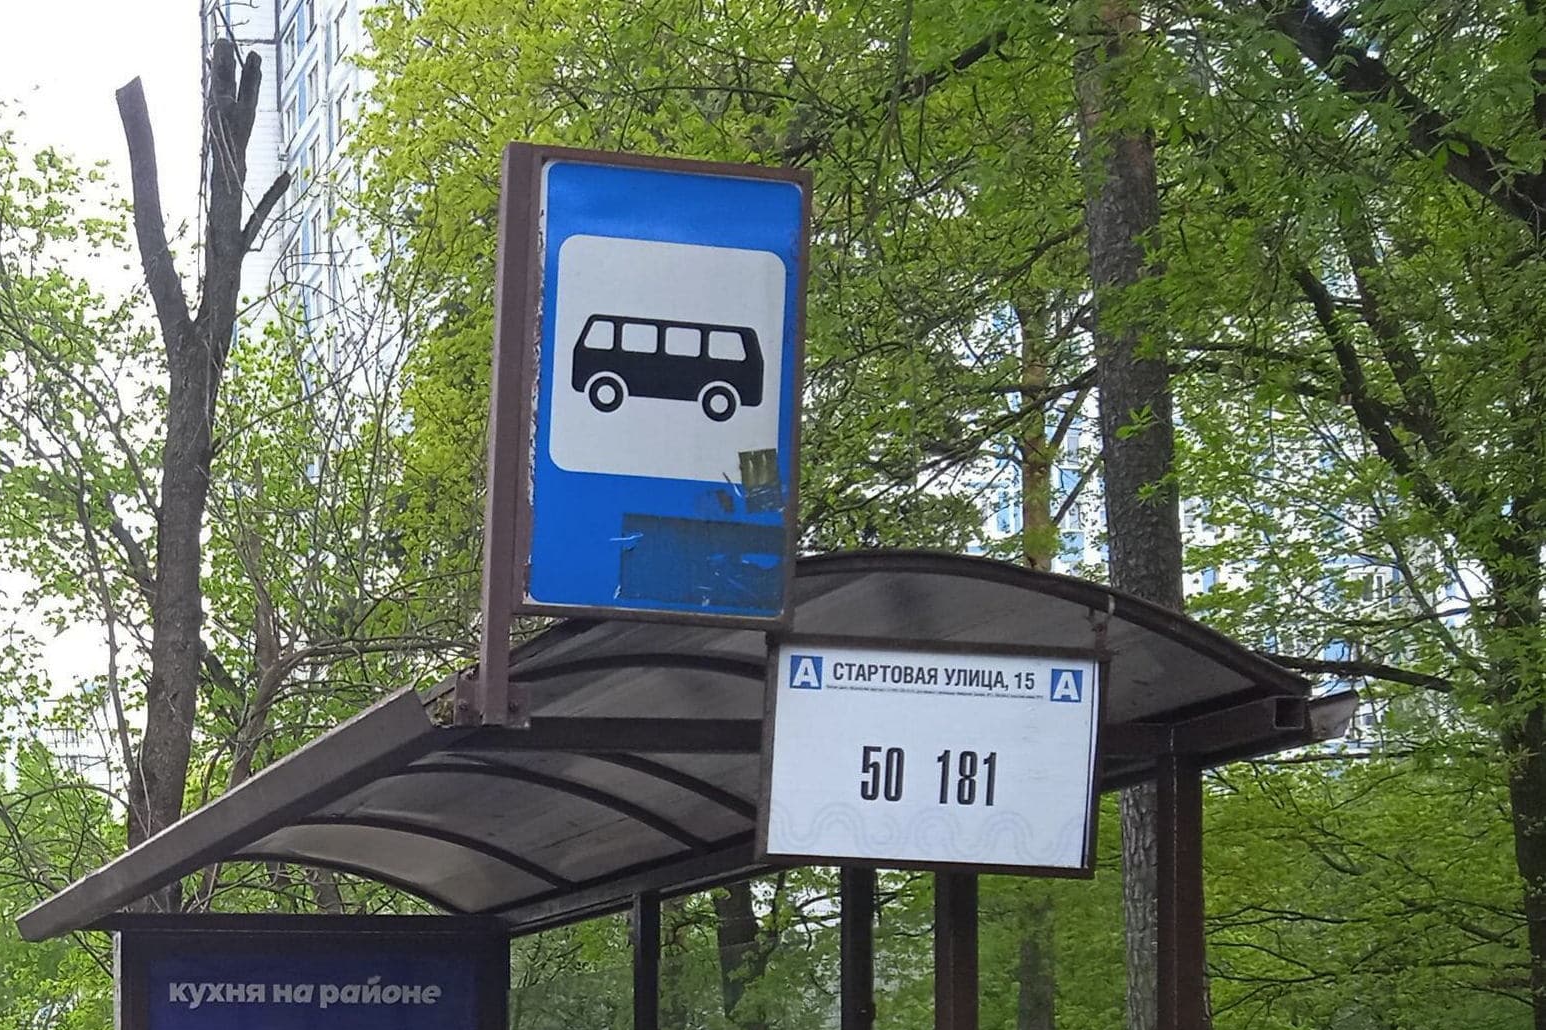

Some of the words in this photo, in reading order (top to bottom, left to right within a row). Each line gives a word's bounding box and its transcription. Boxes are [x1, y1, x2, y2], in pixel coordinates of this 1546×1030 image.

[833, 662, 938, 686] СТАРТОВАЯ
[944, 668, 1010, 691] УЛИЦА,
[1014, 672, 1036, 690] 15
[860, 745, 905, 802] 50
[937, 749, 997, 806] 181
[168, 982, 265, 1009] кухня
[272, 982, 314, 1003] на
[319, 975, 442, 1009] районе
